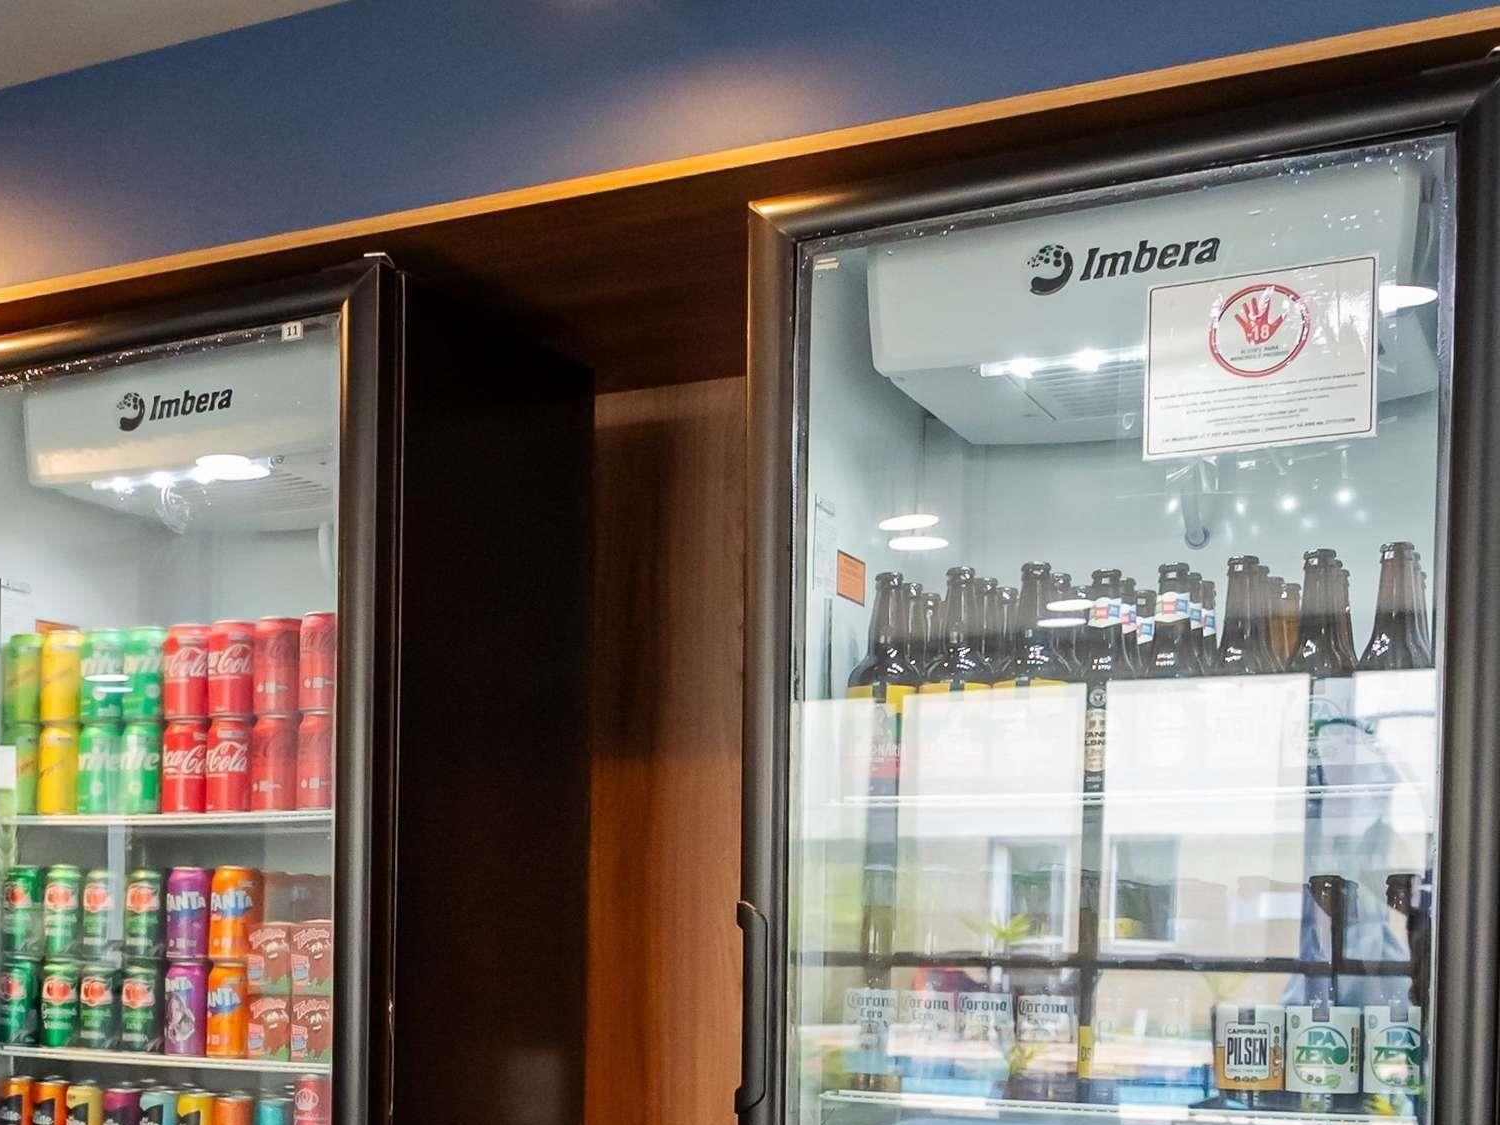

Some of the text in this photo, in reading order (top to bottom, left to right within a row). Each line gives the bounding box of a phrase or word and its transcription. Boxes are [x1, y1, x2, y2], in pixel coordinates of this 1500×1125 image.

[1080, 237, 1221, 282] Imbera
[285, 326, 298, 336] 11
[149, 388, 234, 421] Imbera
[1308, 1031, 1337, 1046] IPA
[1386, 1031, 1416, 1047] IPA
[1227, 1037, 1268, 1066] PILSEN
[1295, 1045, 1349, 1065] ZERO
